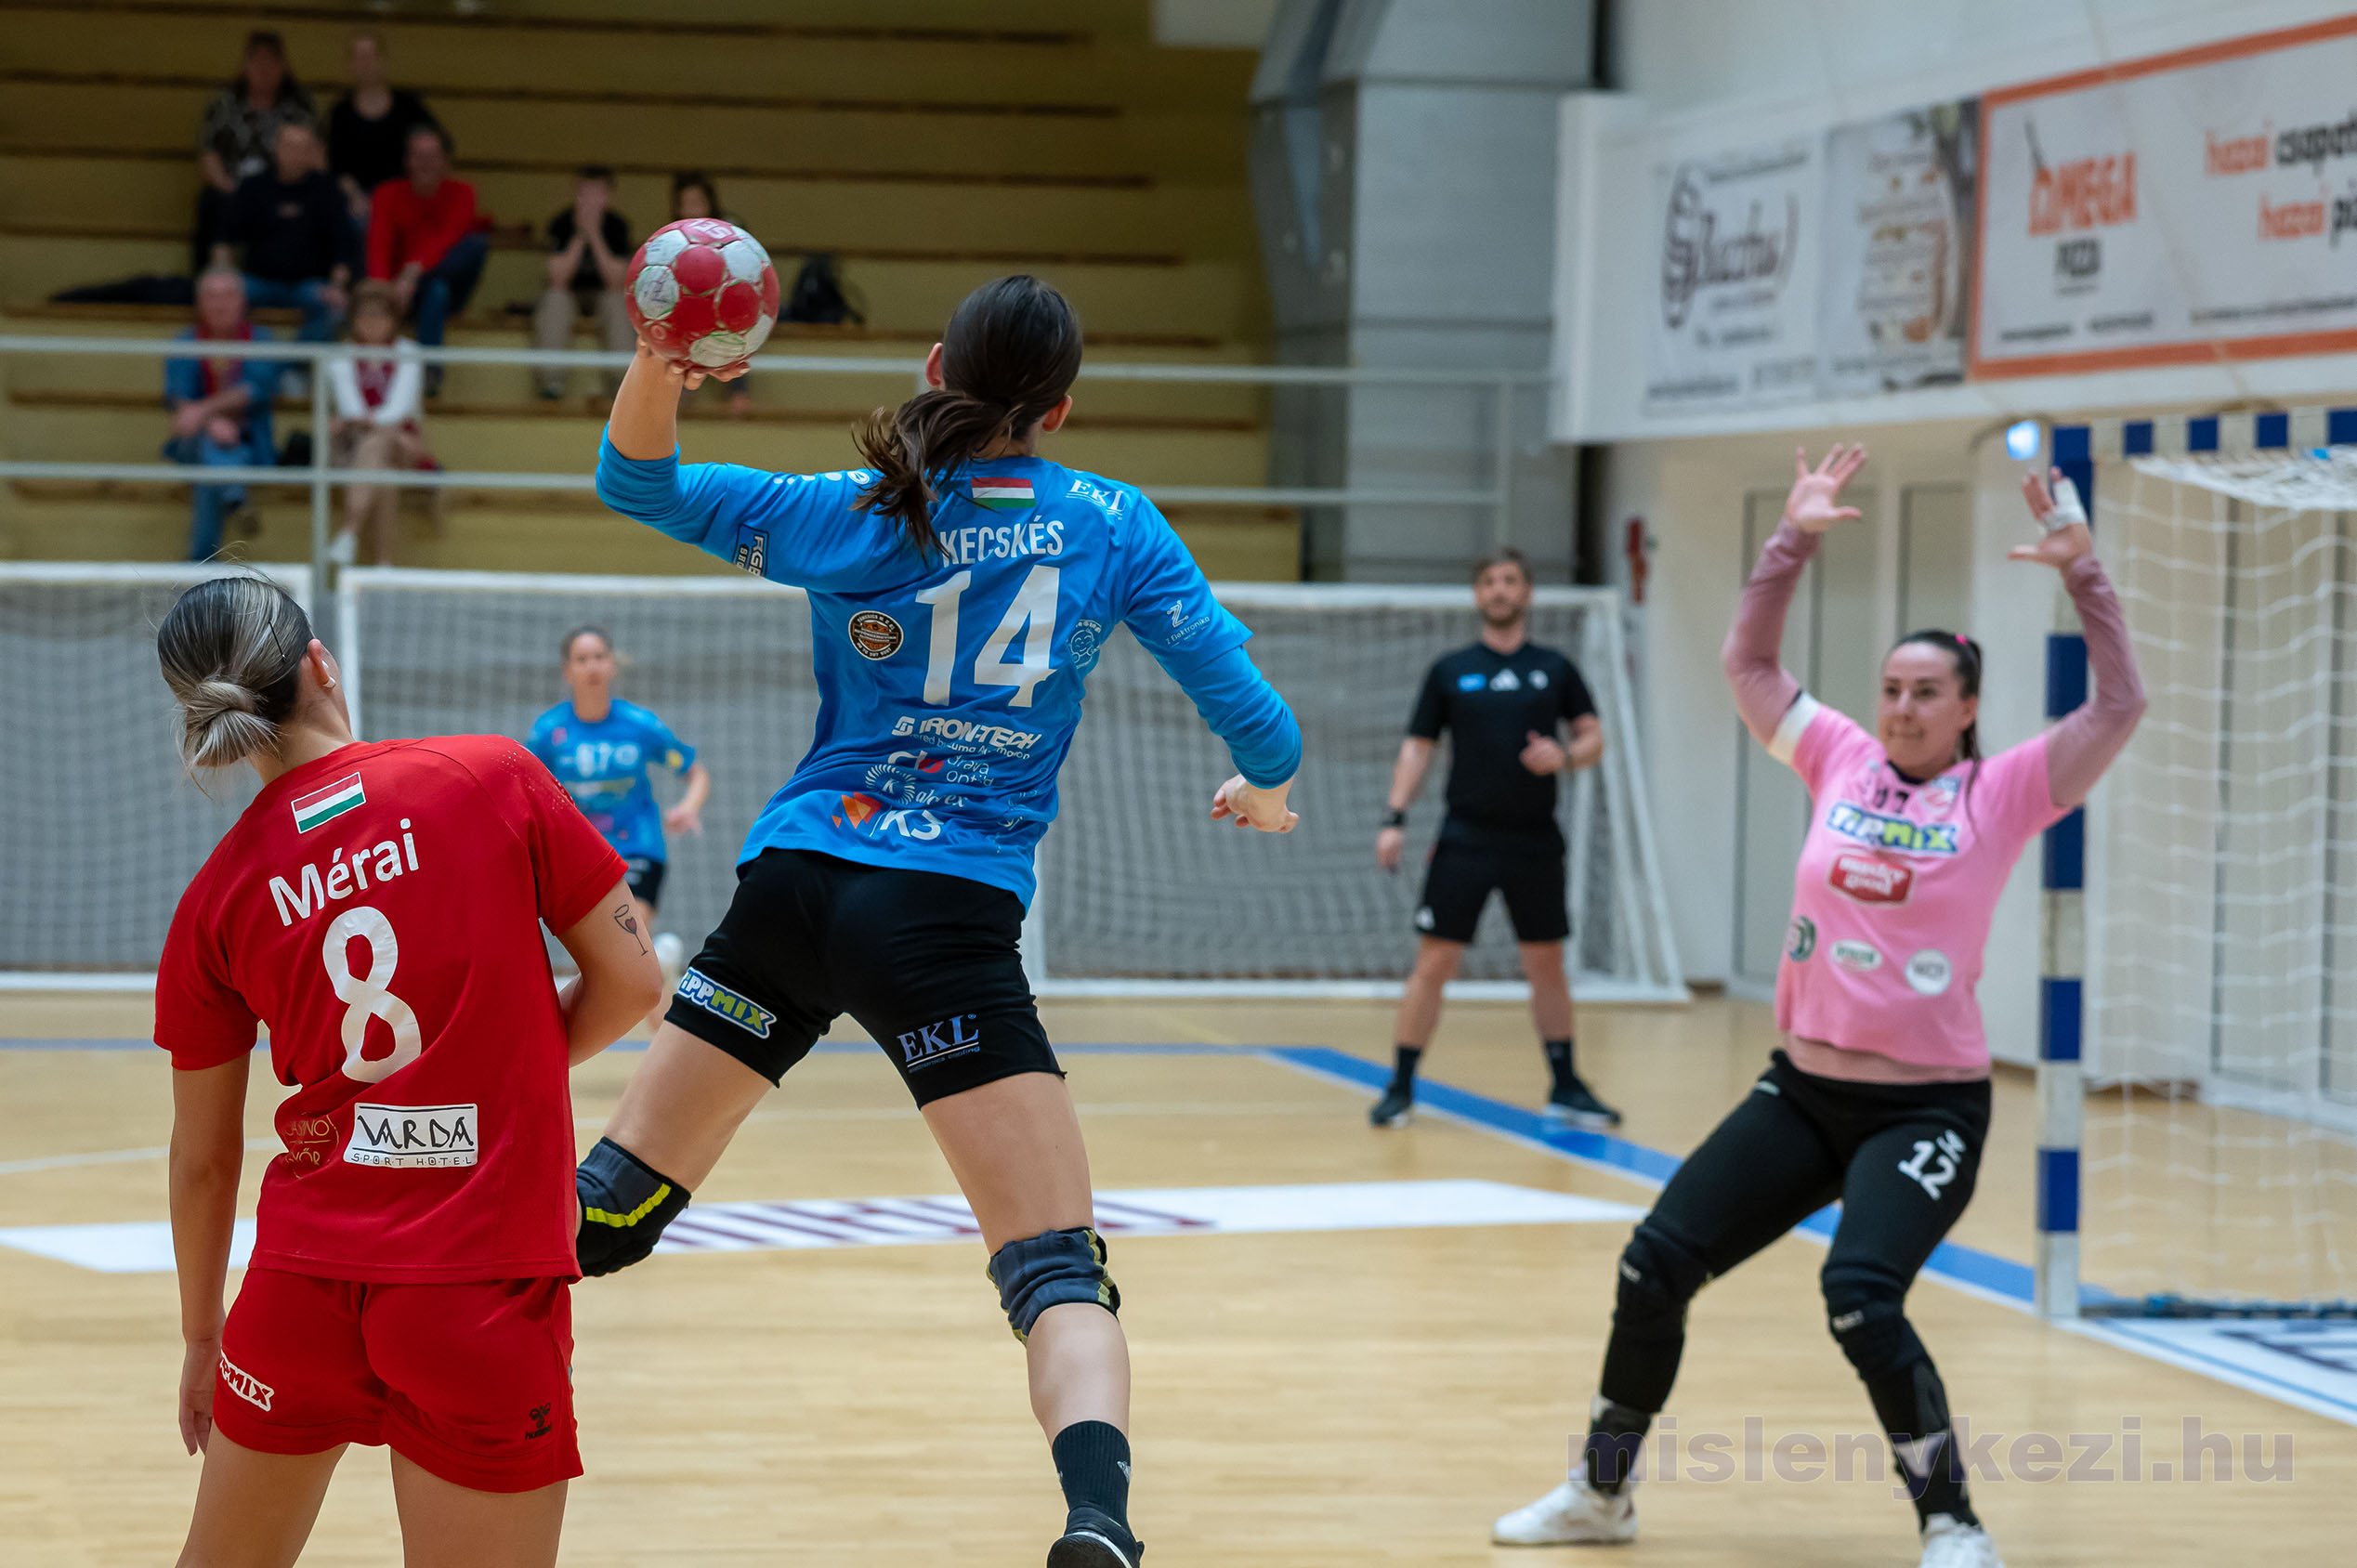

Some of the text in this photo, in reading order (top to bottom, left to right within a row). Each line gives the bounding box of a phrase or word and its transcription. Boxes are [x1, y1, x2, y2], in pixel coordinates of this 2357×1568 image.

[940, 515, 1064, 568] KECSKÉS
[915, 564, 1060, 708] 14
[1171, 616, 1211, 641] Elektronika
[880, 809, 945, 840] K3
[268, 817, 420, 926] Mérai
[321, 906, 422, 1083] 8
[897, 1014, 979, 1063] EKL
[357, 1115, 474, 1149] VARDA
[1897, 1140, 1957, 1200] 12
